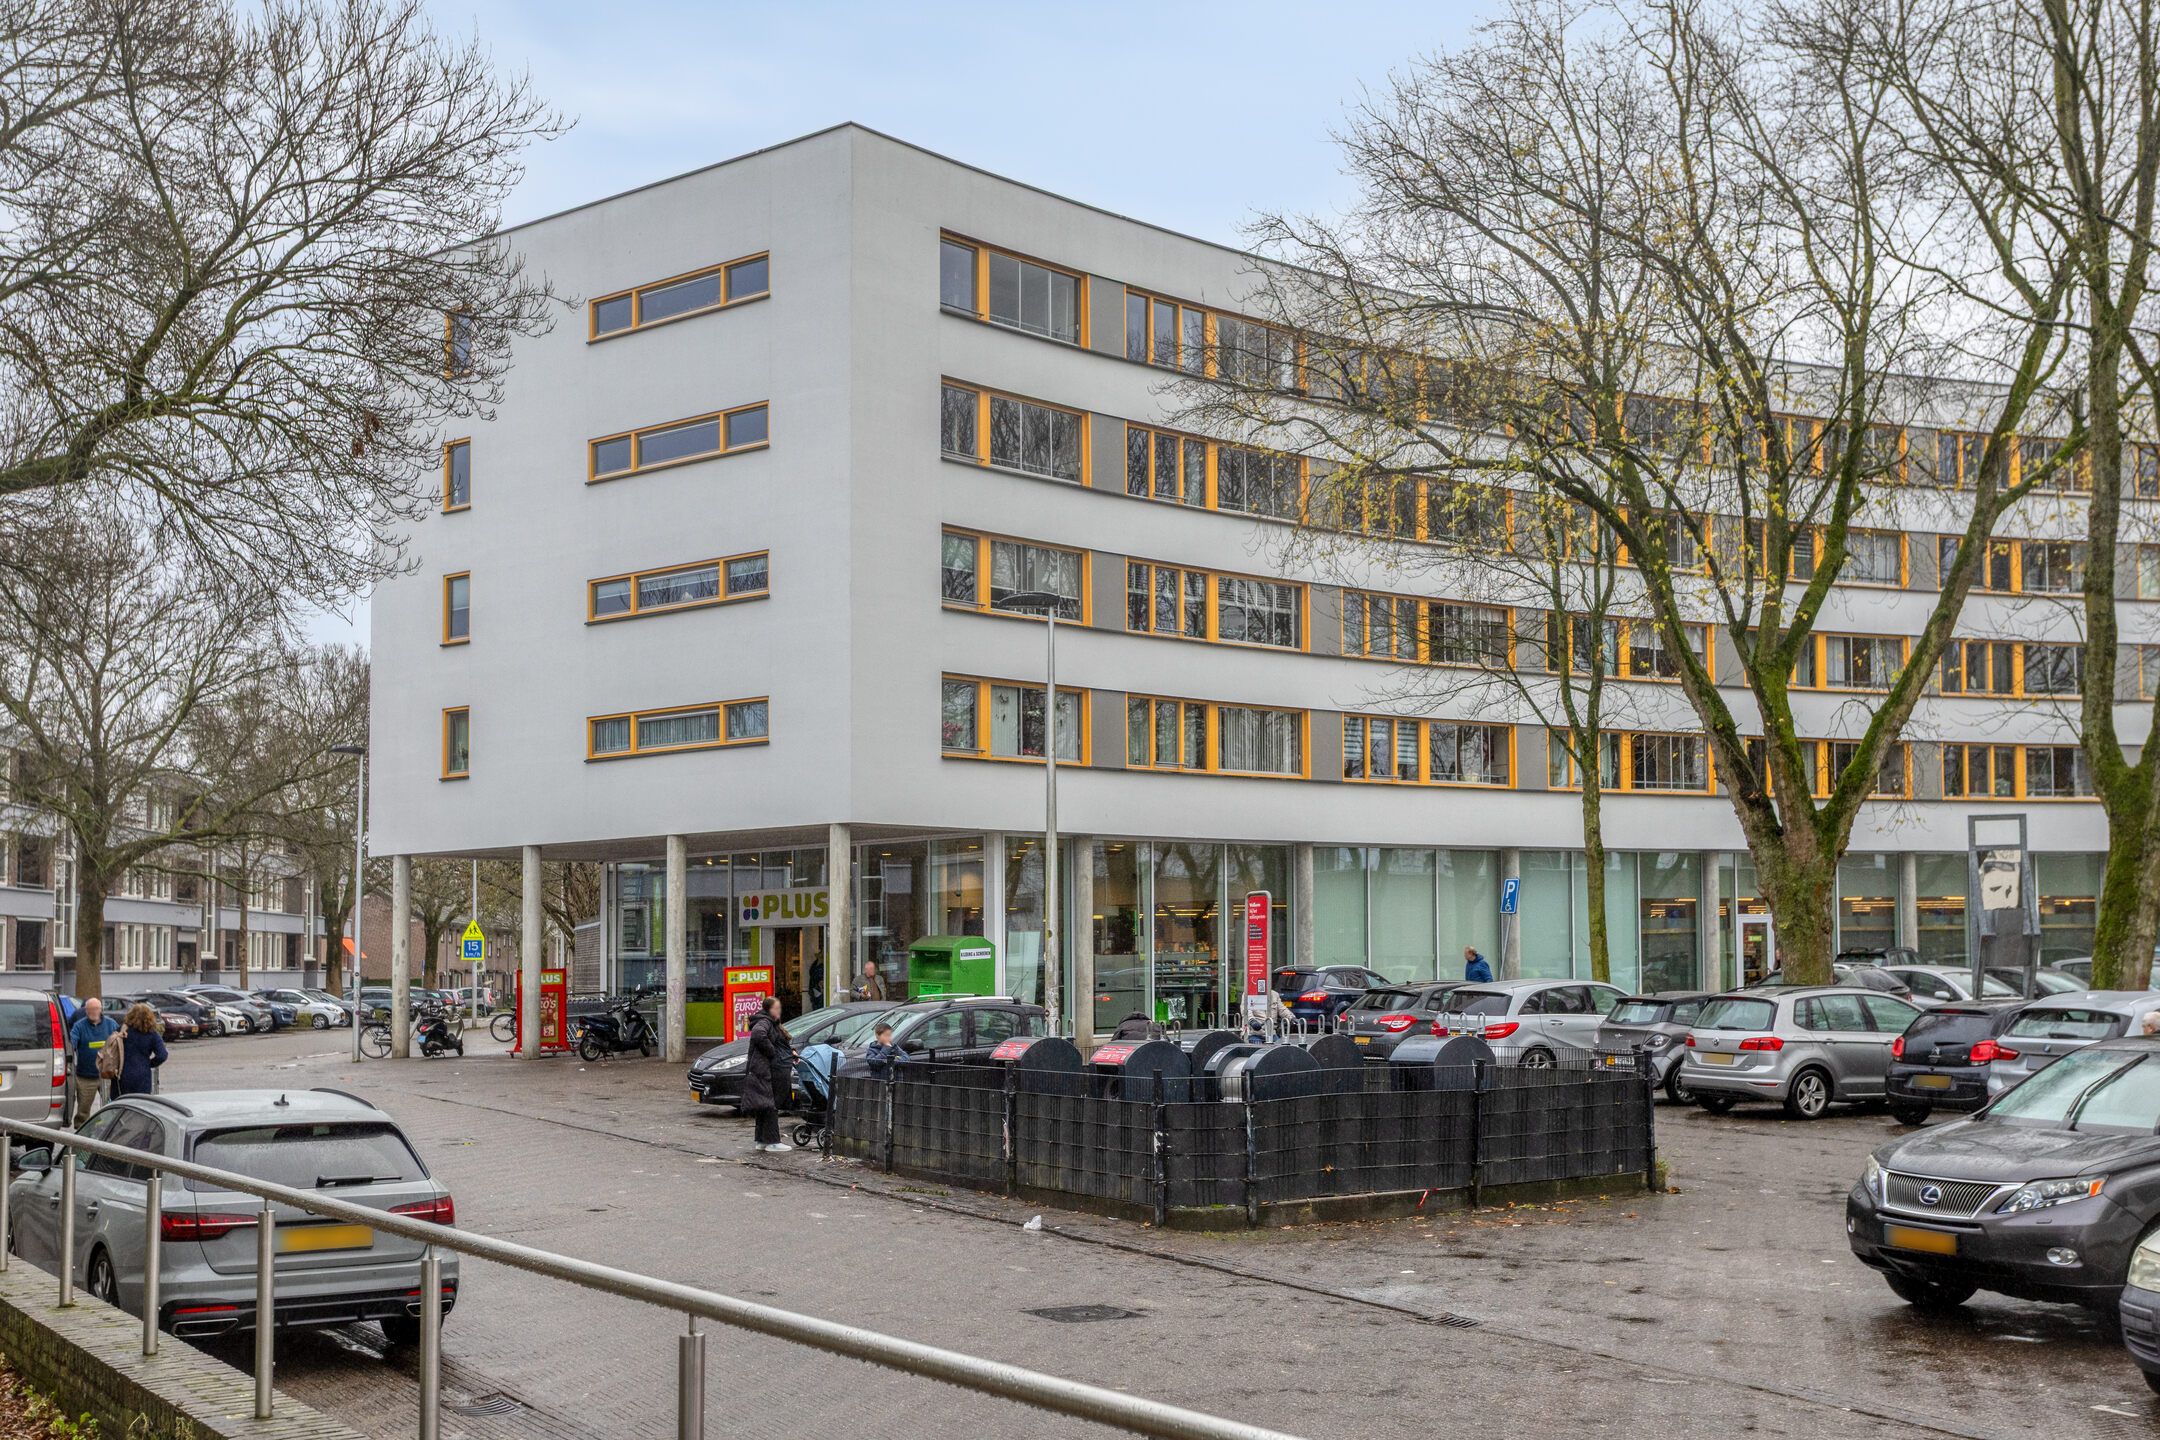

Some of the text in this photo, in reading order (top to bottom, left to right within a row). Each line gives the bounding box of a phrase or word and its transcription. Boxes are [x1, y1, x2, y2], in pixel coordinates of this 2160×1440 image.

[1505, 881, 1516, 898] P
[762, 892, 829, 919] PLUS
[467, 941, 479, 951] 15
[541, 974, 561, 983] LUS
[739, 972, 768, 982] PLUS
[735, 1000, 763, 1012] EURO'S
